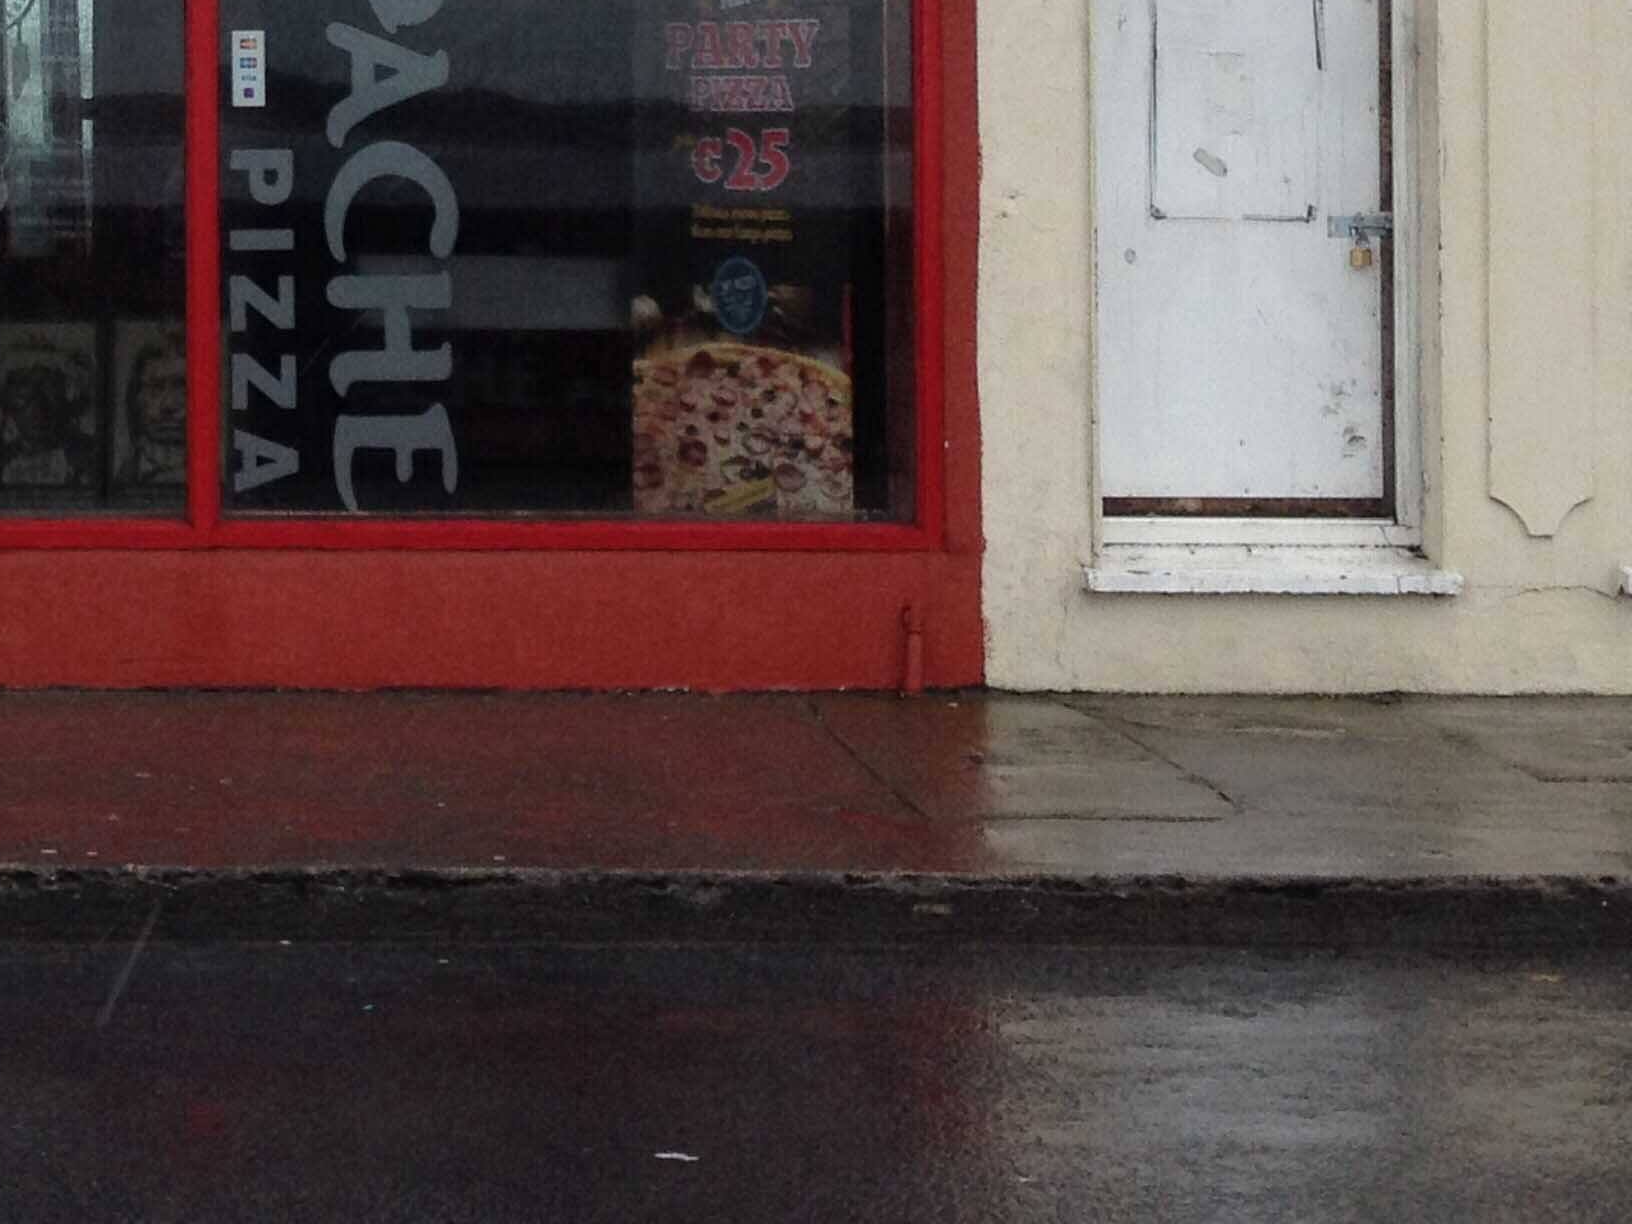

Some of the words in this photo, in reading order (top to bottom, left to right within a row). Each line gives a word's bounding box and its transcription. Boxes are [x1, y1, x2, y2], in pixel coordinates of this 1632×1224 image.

[664, 19, 820, 71] PARTY
[690, 75, 795, 113] PIZZA
[229, 149, 300, 493] PIZZA
